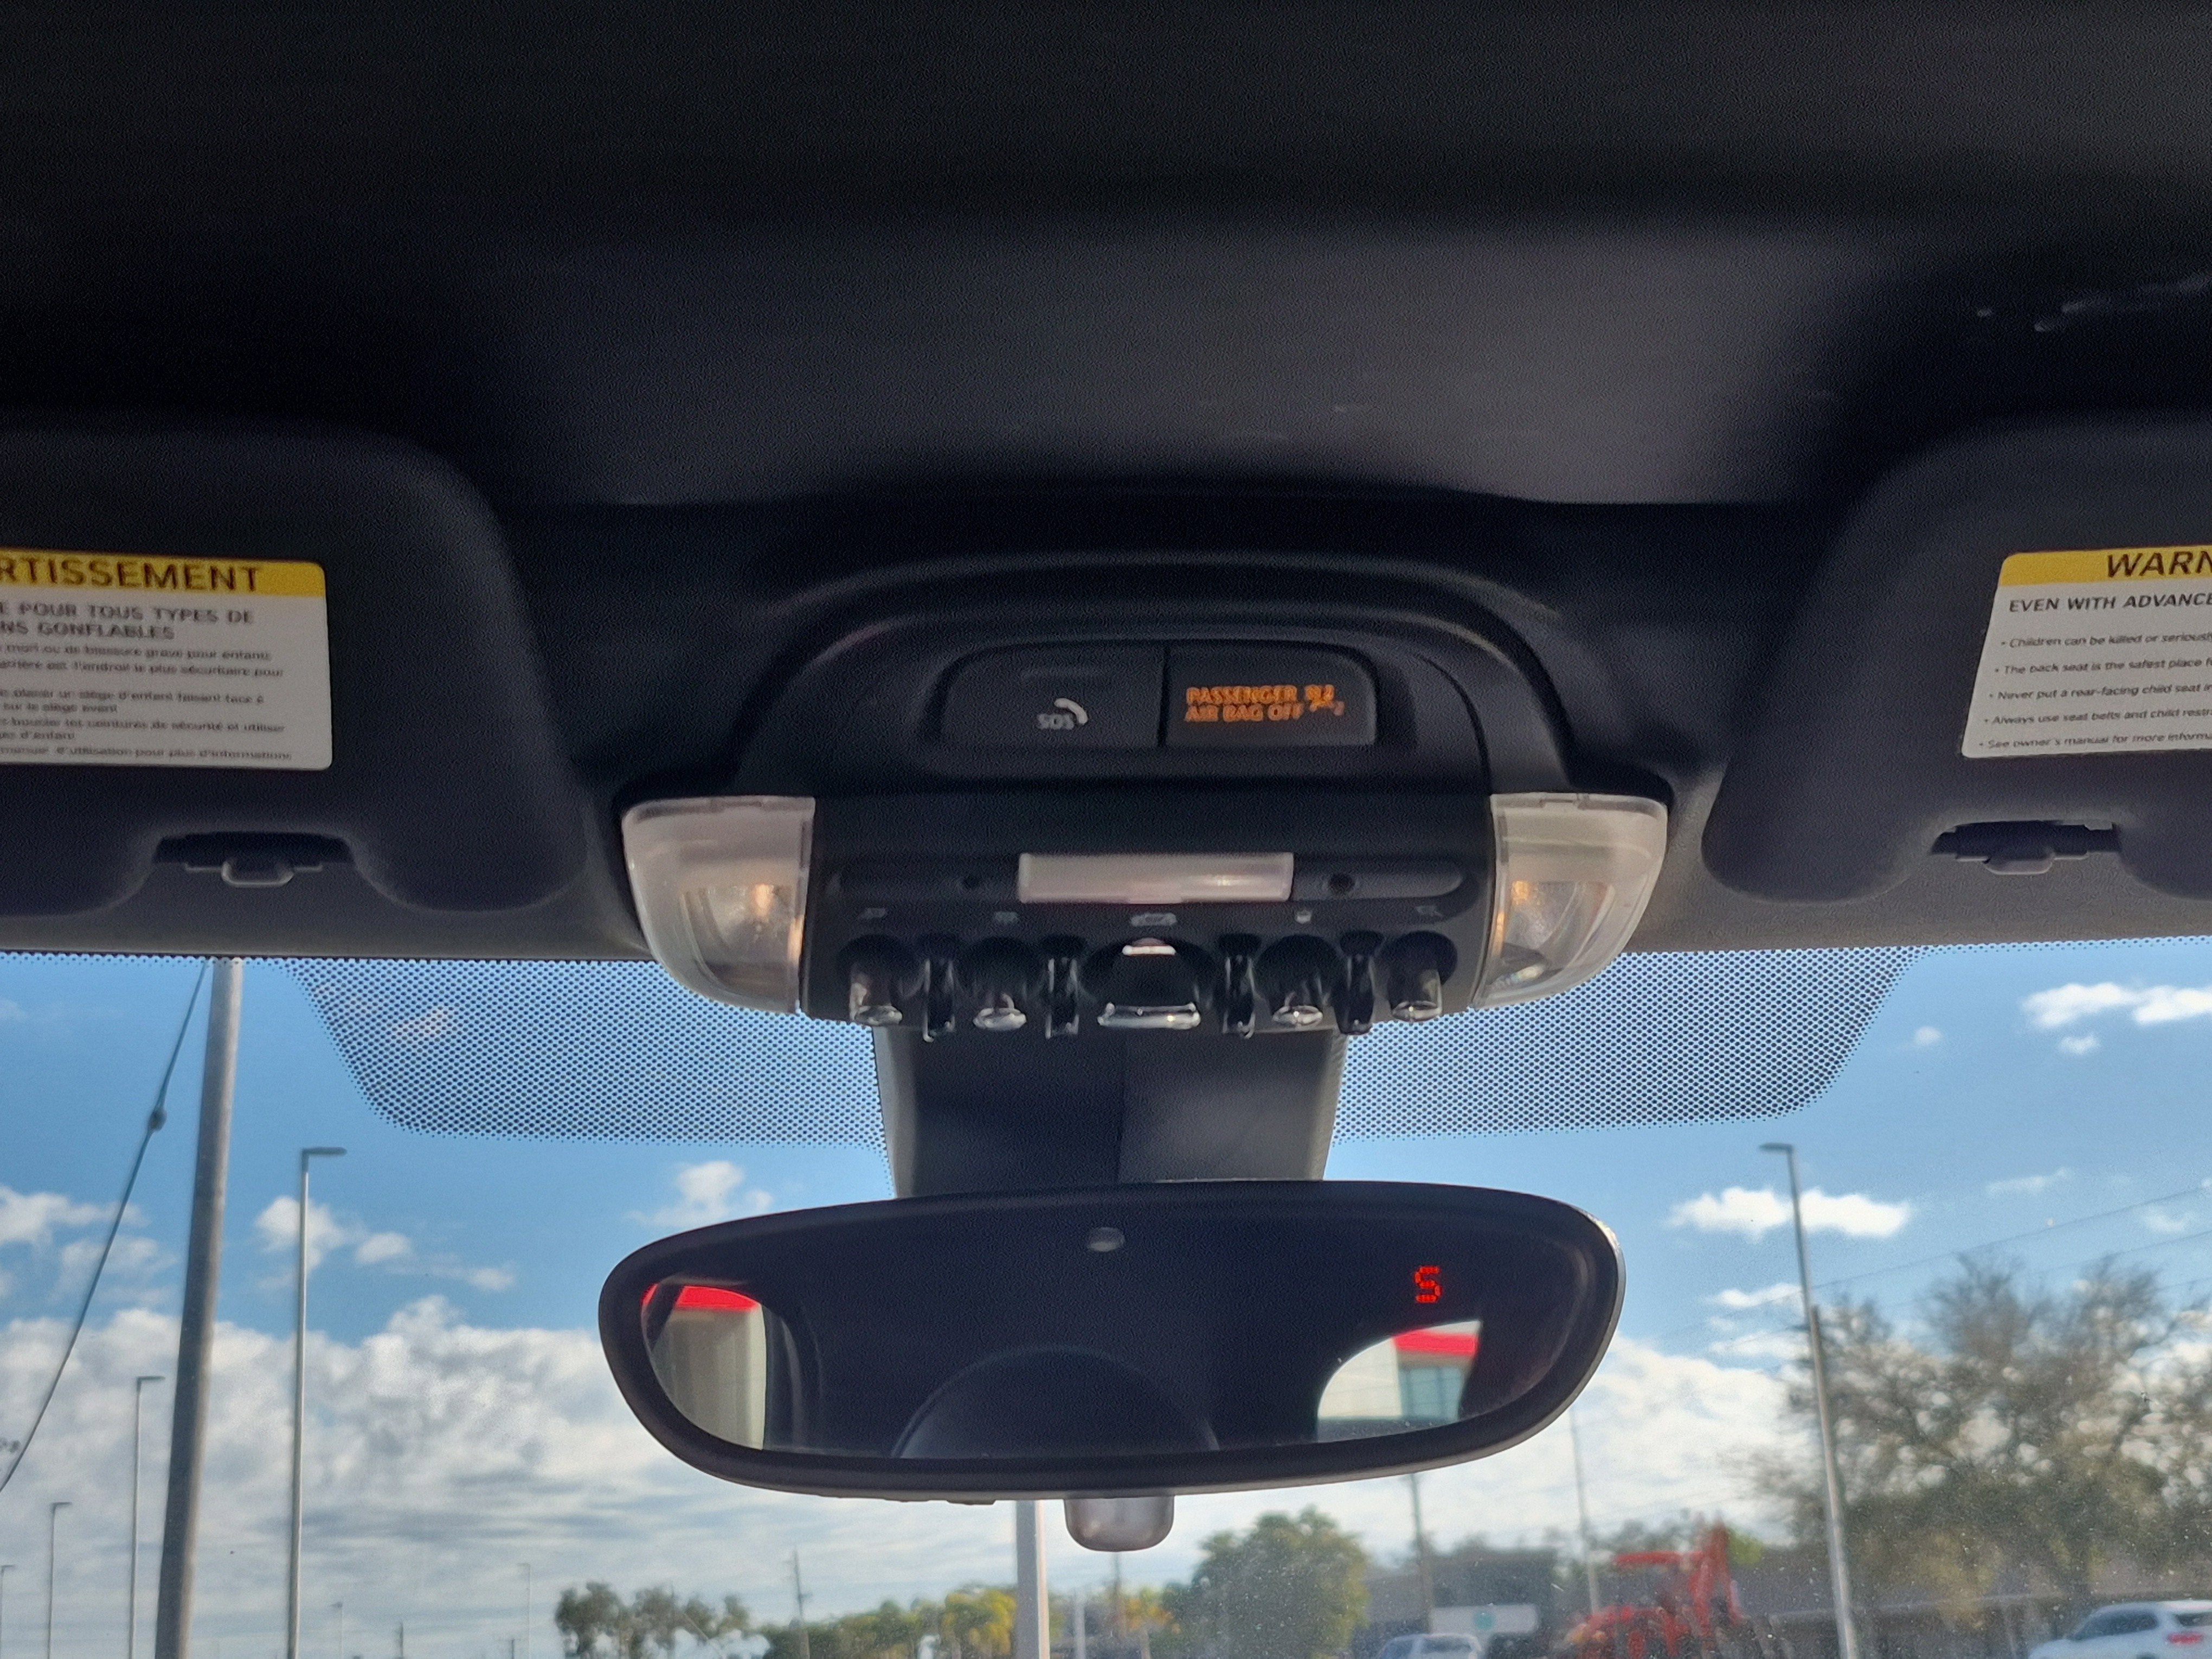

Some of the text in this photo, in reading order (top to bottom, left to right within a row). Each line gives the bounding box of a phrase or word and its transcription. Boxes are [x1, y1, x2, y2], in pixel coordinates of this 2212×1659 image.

[2107, 550, 2212, 578] WARN
[0, 555, 262, 591] RTISSEMENT
[19, 602, 76, 616] POUR
[88, 604, 143, 620] TOUS
[152, 607, 219, 623] TYPES
[2009, 598, 2059, 613] EVEN
[2067, 597, 2115, 610] WITH
[2009, 638, 2061, 648] Children
[2064, 637, 2087, 646] can
[2089, 636, 2105, 646] be
[2108, 635, 2142, 644] killed
[2005, 665, 2026, 674] The
[2029, 663, 2059, 673] back
[2062, 663, 2088, 672] seat
[2091, 663, 2101, 671] is
[2105, 661, 2125, 671] the
[2129, 658, 2166, 669] safest
[2168, 659, 2202, 670] place
[1997, 691, 2034, 700] Never
[2036, 689, 2060, 699] put
[2070, 685, 2139, 698] rear-facing
[2142, 684, 2173, 695] child
[2175, 684, 2201, 693] seat
[1037, 713, 1075, 730] SOS
[1992, 715, 2035, 725] Always
[2038, 715, 2060, 723] use
[2063, 713, 2088, 722] seat
[2091, 711, 2121, 721] belts
[2124, 710, 2147, 719] and
[2150, 708, 2180, 718] child
[1988, 739, 2010, 748] See
[2013, 737, 2061, 748] owner's
[2064, 736, 2109, 746] manual
[2112, 735, 2129, 744] for
[2132, 734, 2165, 743] more
